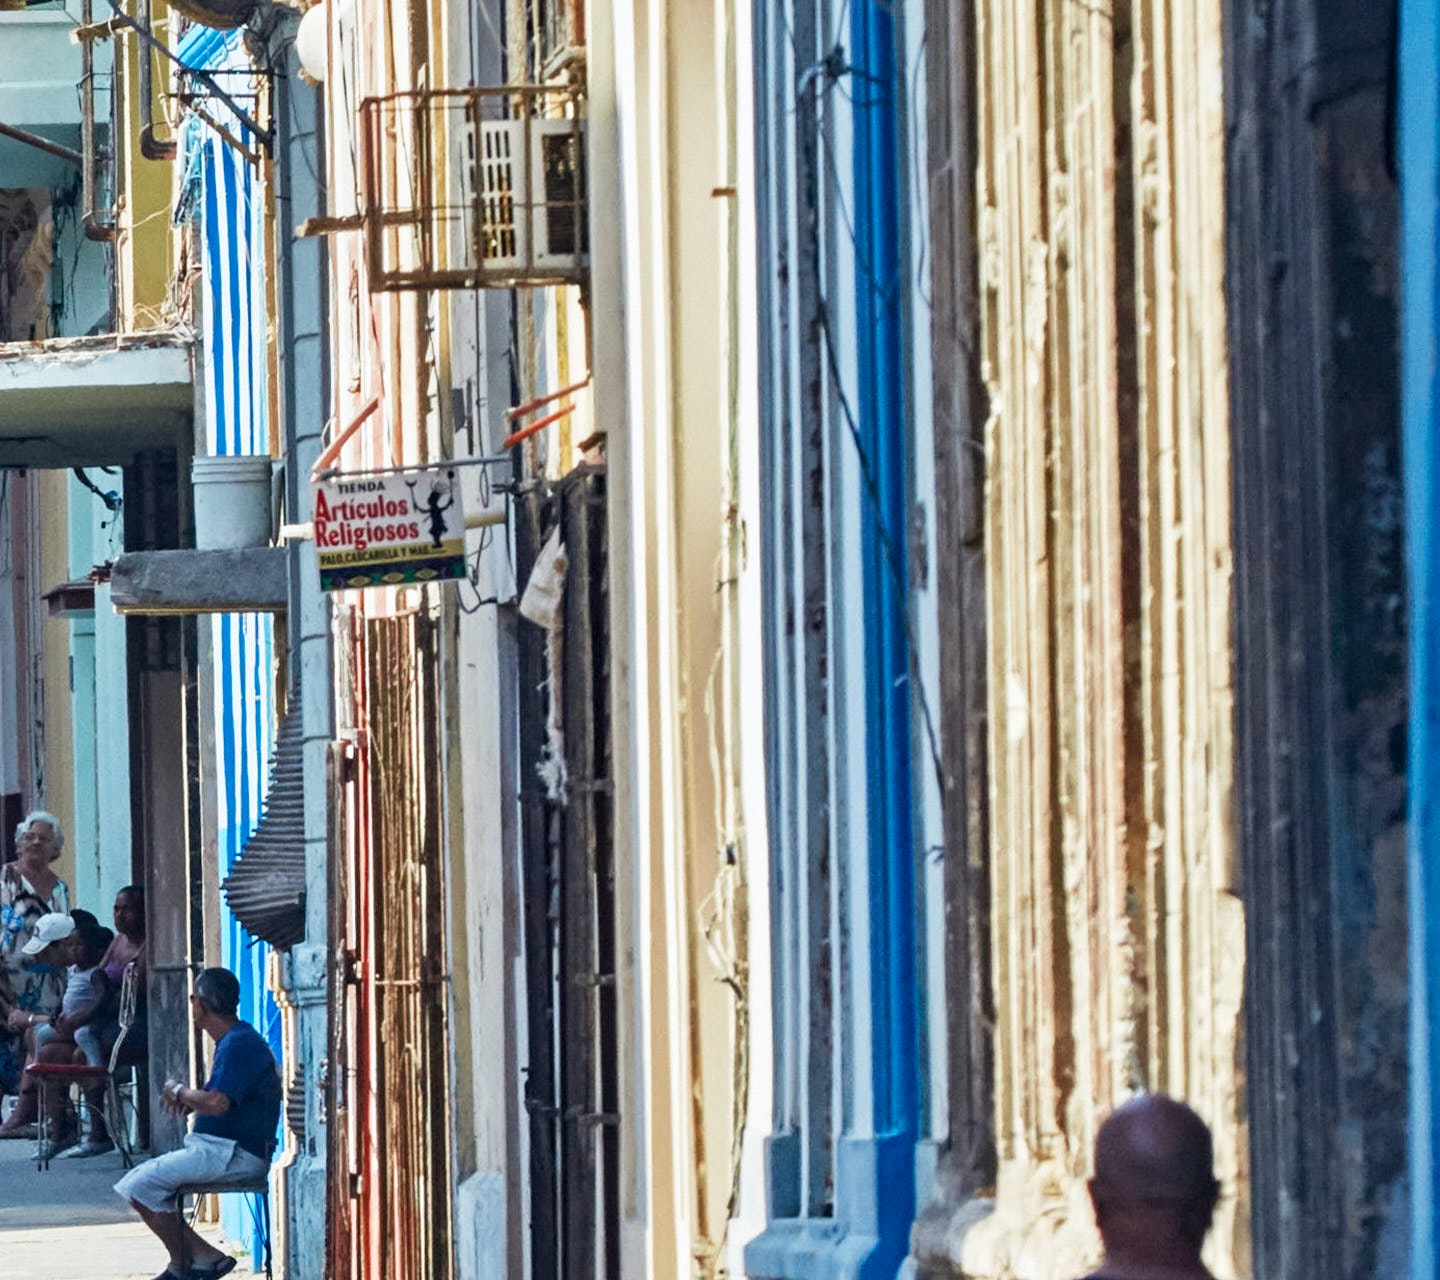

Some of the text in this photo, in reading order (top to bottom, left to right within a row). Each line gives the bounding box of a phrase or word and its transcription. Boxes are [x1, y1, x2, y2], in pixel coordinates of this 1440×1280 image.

[338, 481, 386, 494] TIENDA
[315, 488, 409, 521] Artículos
[314, 517, 419, 551] Religiosos
